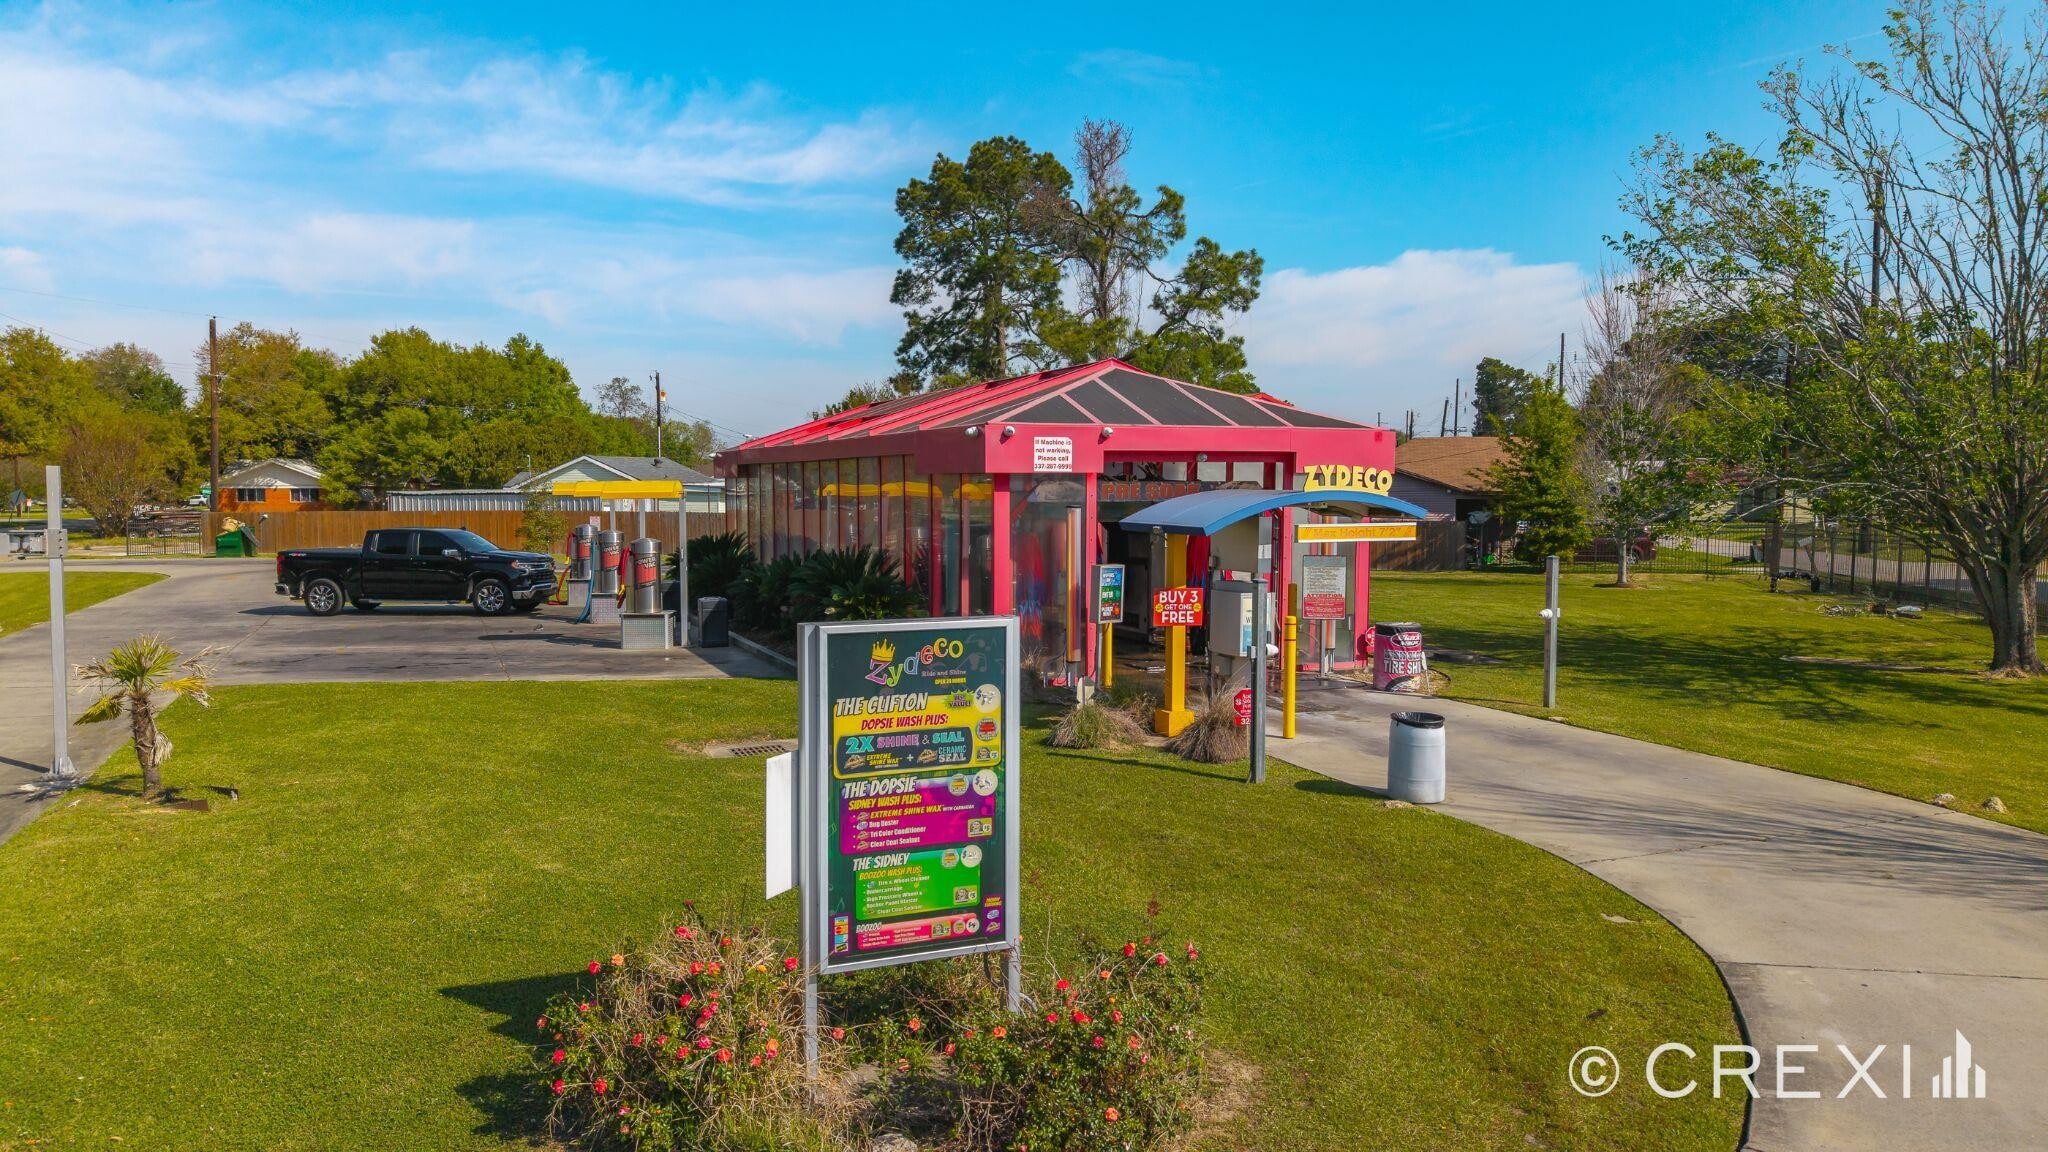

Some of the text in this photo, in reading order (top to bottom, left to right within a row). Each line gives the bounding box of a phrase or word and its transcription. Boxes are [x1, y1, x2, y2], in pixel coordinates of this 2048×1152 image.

[1304, 465, 1393, 494] ZYDECO
[1102, 483, 1140, 499] PRE
[1314, 529, 1336, 538] Max
[1340, 528, 1376, 538] Height
[1159, 591, 1199, 603] BUY 3
[1161, 611, 1195, 623] FREE
[865, 637, 964, 687] Zydeco
[1384, 660, 1422, 674] TIRE SHI
[836, 691, 928, 717] THE CLIFTON
[861, 713, 949, 730] DOPSIE WASH PLUS:
[845, 731, 965, 754] 2X SHINE & SEAL
[939, 745, 967, 754] CERAMIC
[939, 753, 967, 762] SEAL
[844, 776, 918, 799] THE DOPSIE
[848, 793, 922, 810] SIDNEY WASH PLUS:
[870, 809, 902, 818] EXTREME
[904, 806, 925, 816] SHINE
[926, 805, 941, 813] WAX
[879, 829, 894, 837] Color
[894, 826, 926, 835] Conditioner
[870, 840, 885, 848] Clear
[853, 852, 910, 871] THE SIDNEY
[859, 870, 886, 880] BOOZOO
[887, 868, 905, 876] WASH
[856, 922, 882, 933] BOOZOO
